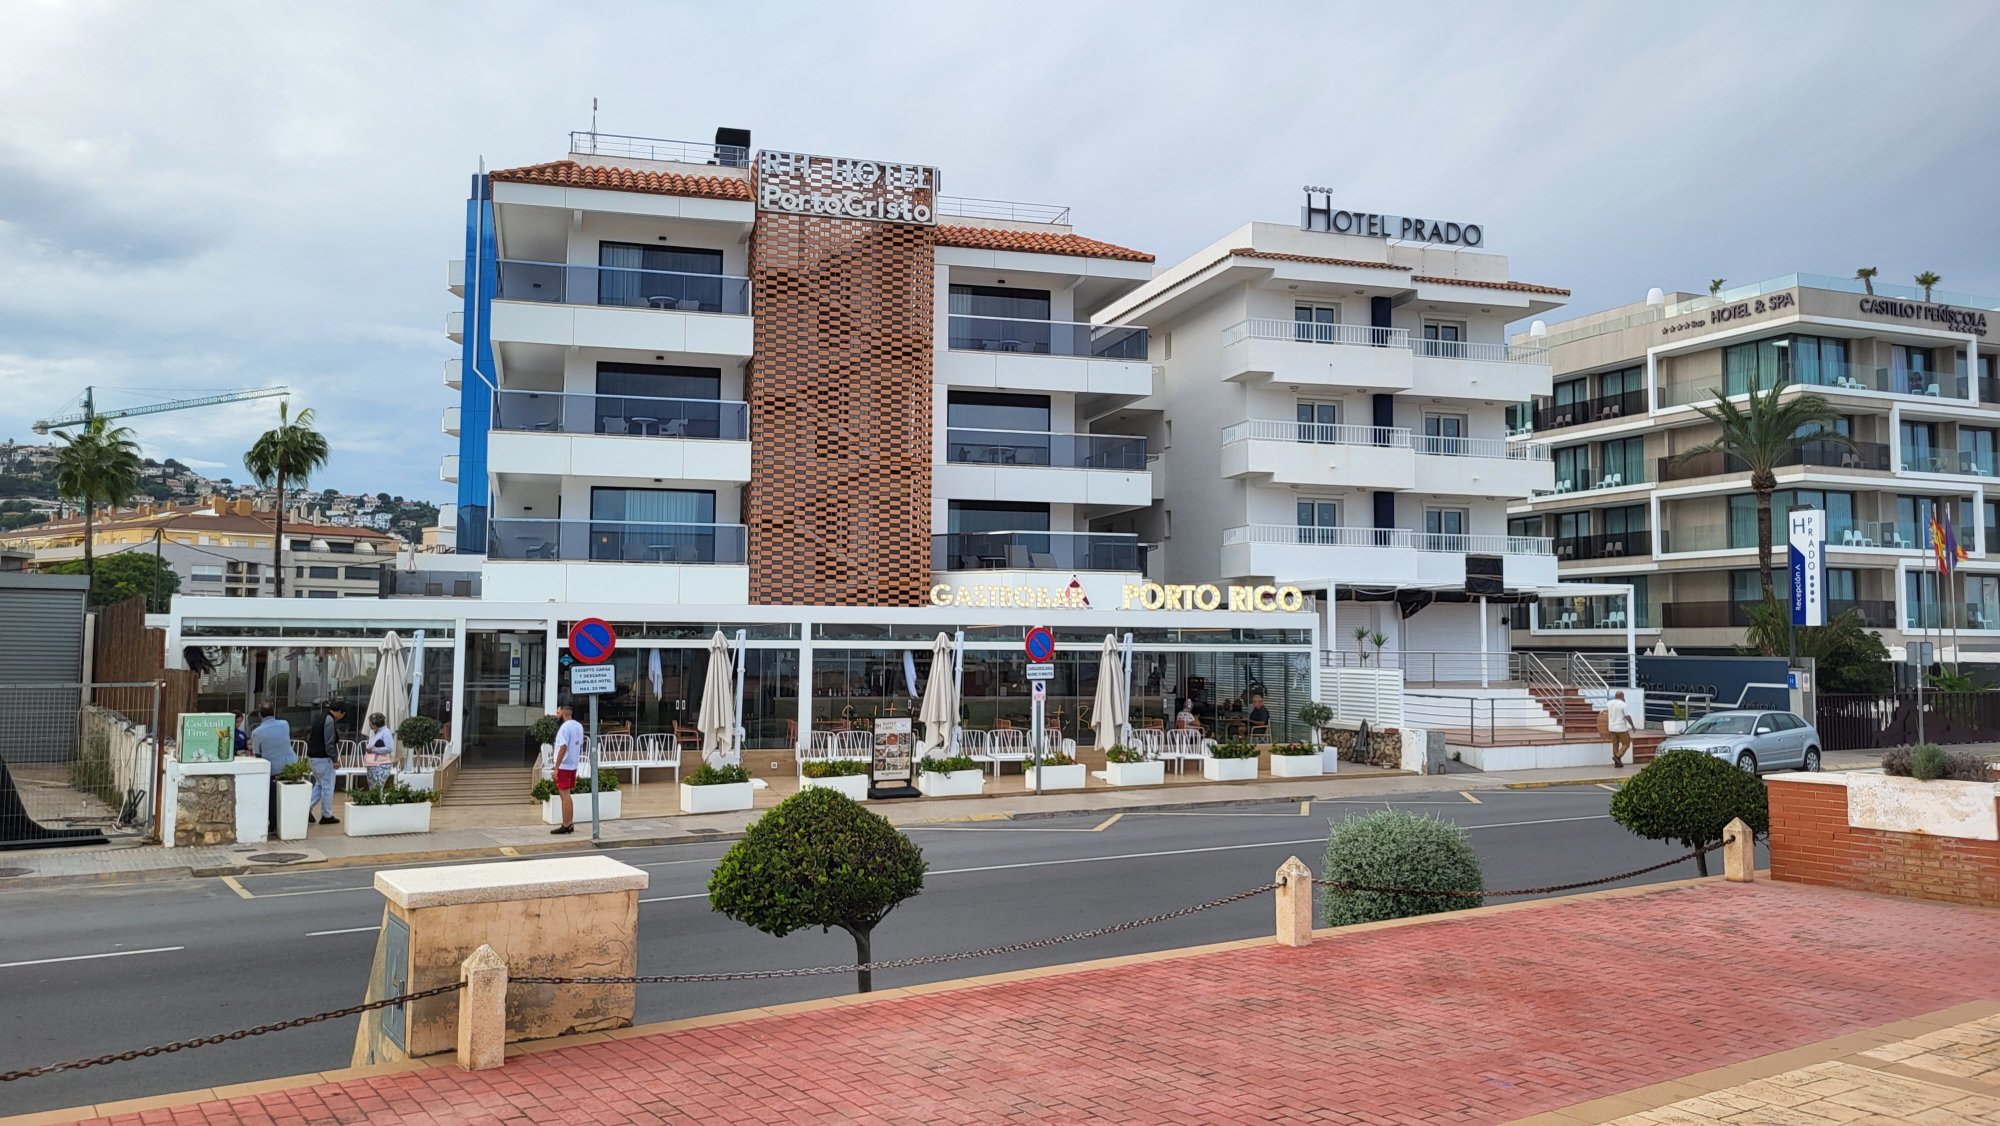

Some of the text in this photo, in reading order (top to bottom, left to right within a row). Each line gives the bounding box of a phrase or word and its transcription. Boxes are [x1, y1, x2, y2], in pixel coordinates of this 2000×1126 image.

[765, 151, 930, 188] RH HOTEL
[764, 185, 931, 222] PortoCristo
[1306, 193, 1482, 246] HOTEL PRADO
[1711, 303, 1752, 324] HOTEL
[1755, 300, 1767, 314] &
[1768, 293, 1795, 311] SPA
[1859, 298, 1915, 318] CASTILLO
[1807, 517, 1816, 570] PRADO
[929, 584, 1086, 608] GASTROBAR
[1122, 582, 1302, 612] PORTO RICO
[186, 719, 224, 728] Cocktail
[187, 729, 209, 737] Time
